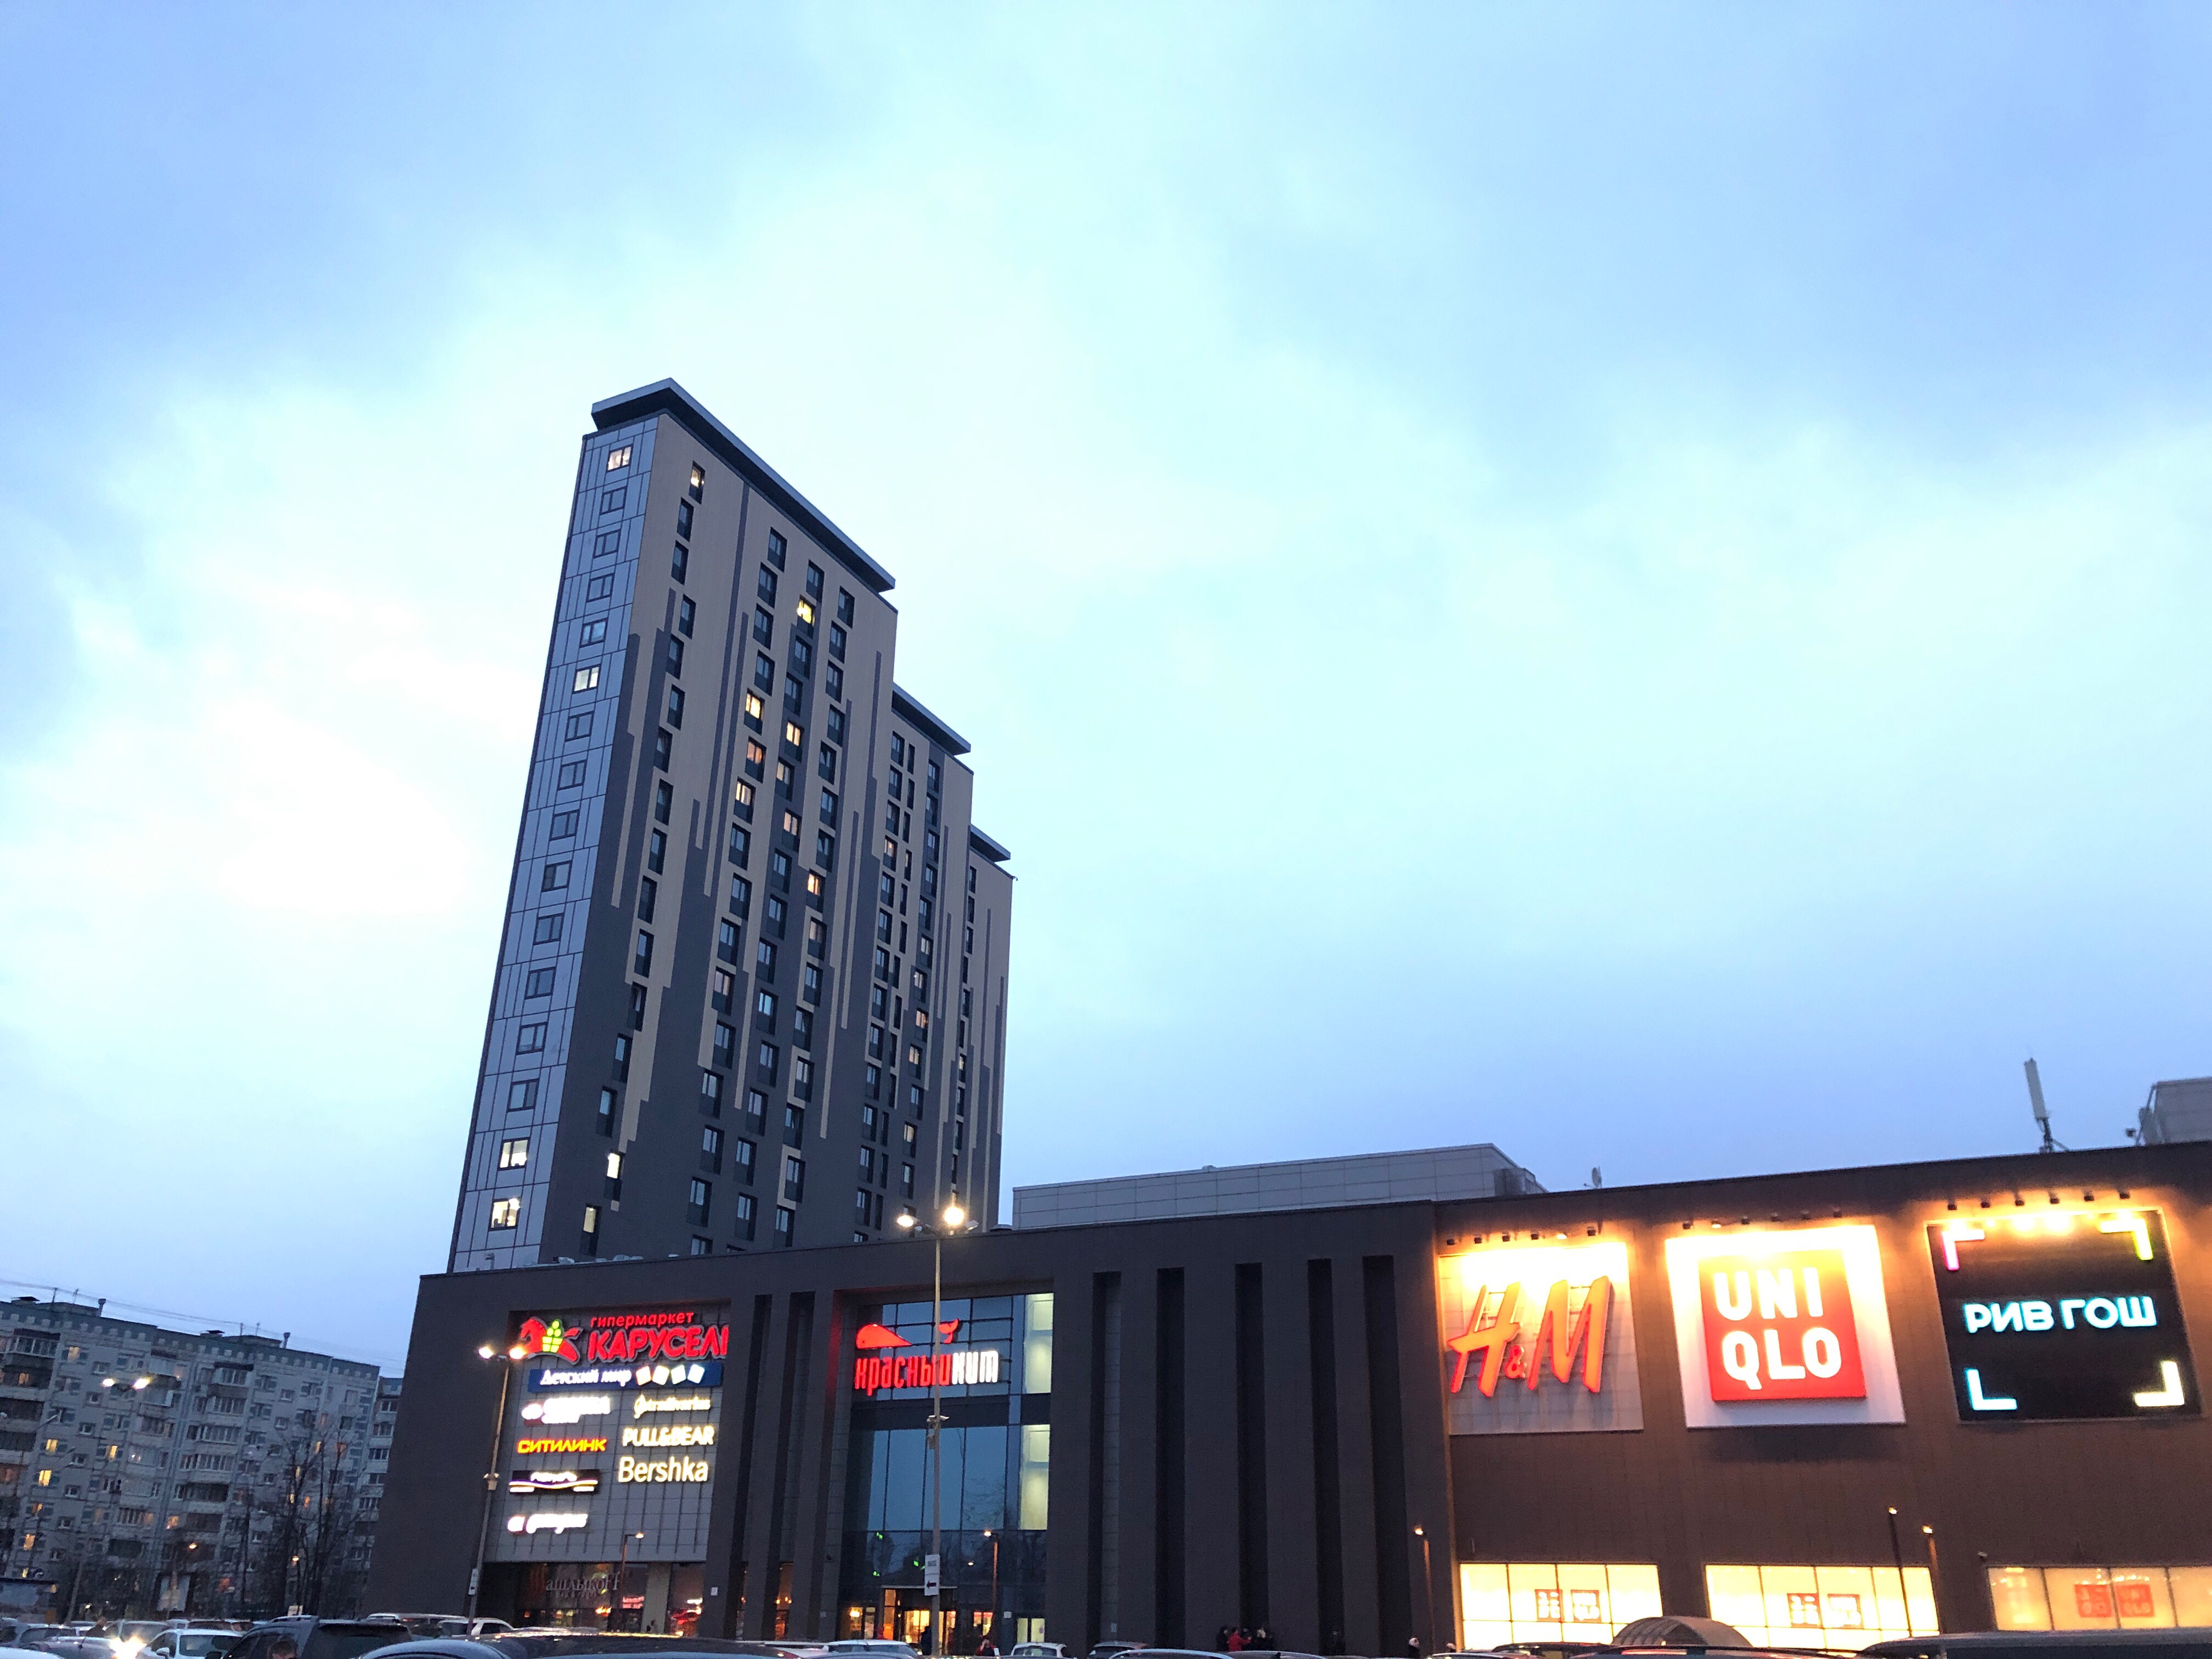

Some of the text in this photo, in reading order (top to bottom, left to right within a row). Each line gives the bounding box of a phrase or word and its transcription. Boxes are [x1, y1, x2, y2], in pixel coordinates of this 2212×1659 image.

[1713, 1267, 1824, 1321] UNI
[590, 1312, 695, 1329] гипермаркет
[1964, 1296, 2157, 1333] РИВ ГОШ
[1447, 1276, 1611, 1397] H&M
[1722, 1327, 1842, 1390] QLO
[517, 1439, 607, 1453] СИТИЛИНК
[622, 1425, 714, 1447] PULL&BEAR
[618, 1455, 709, 1482] Bershka
